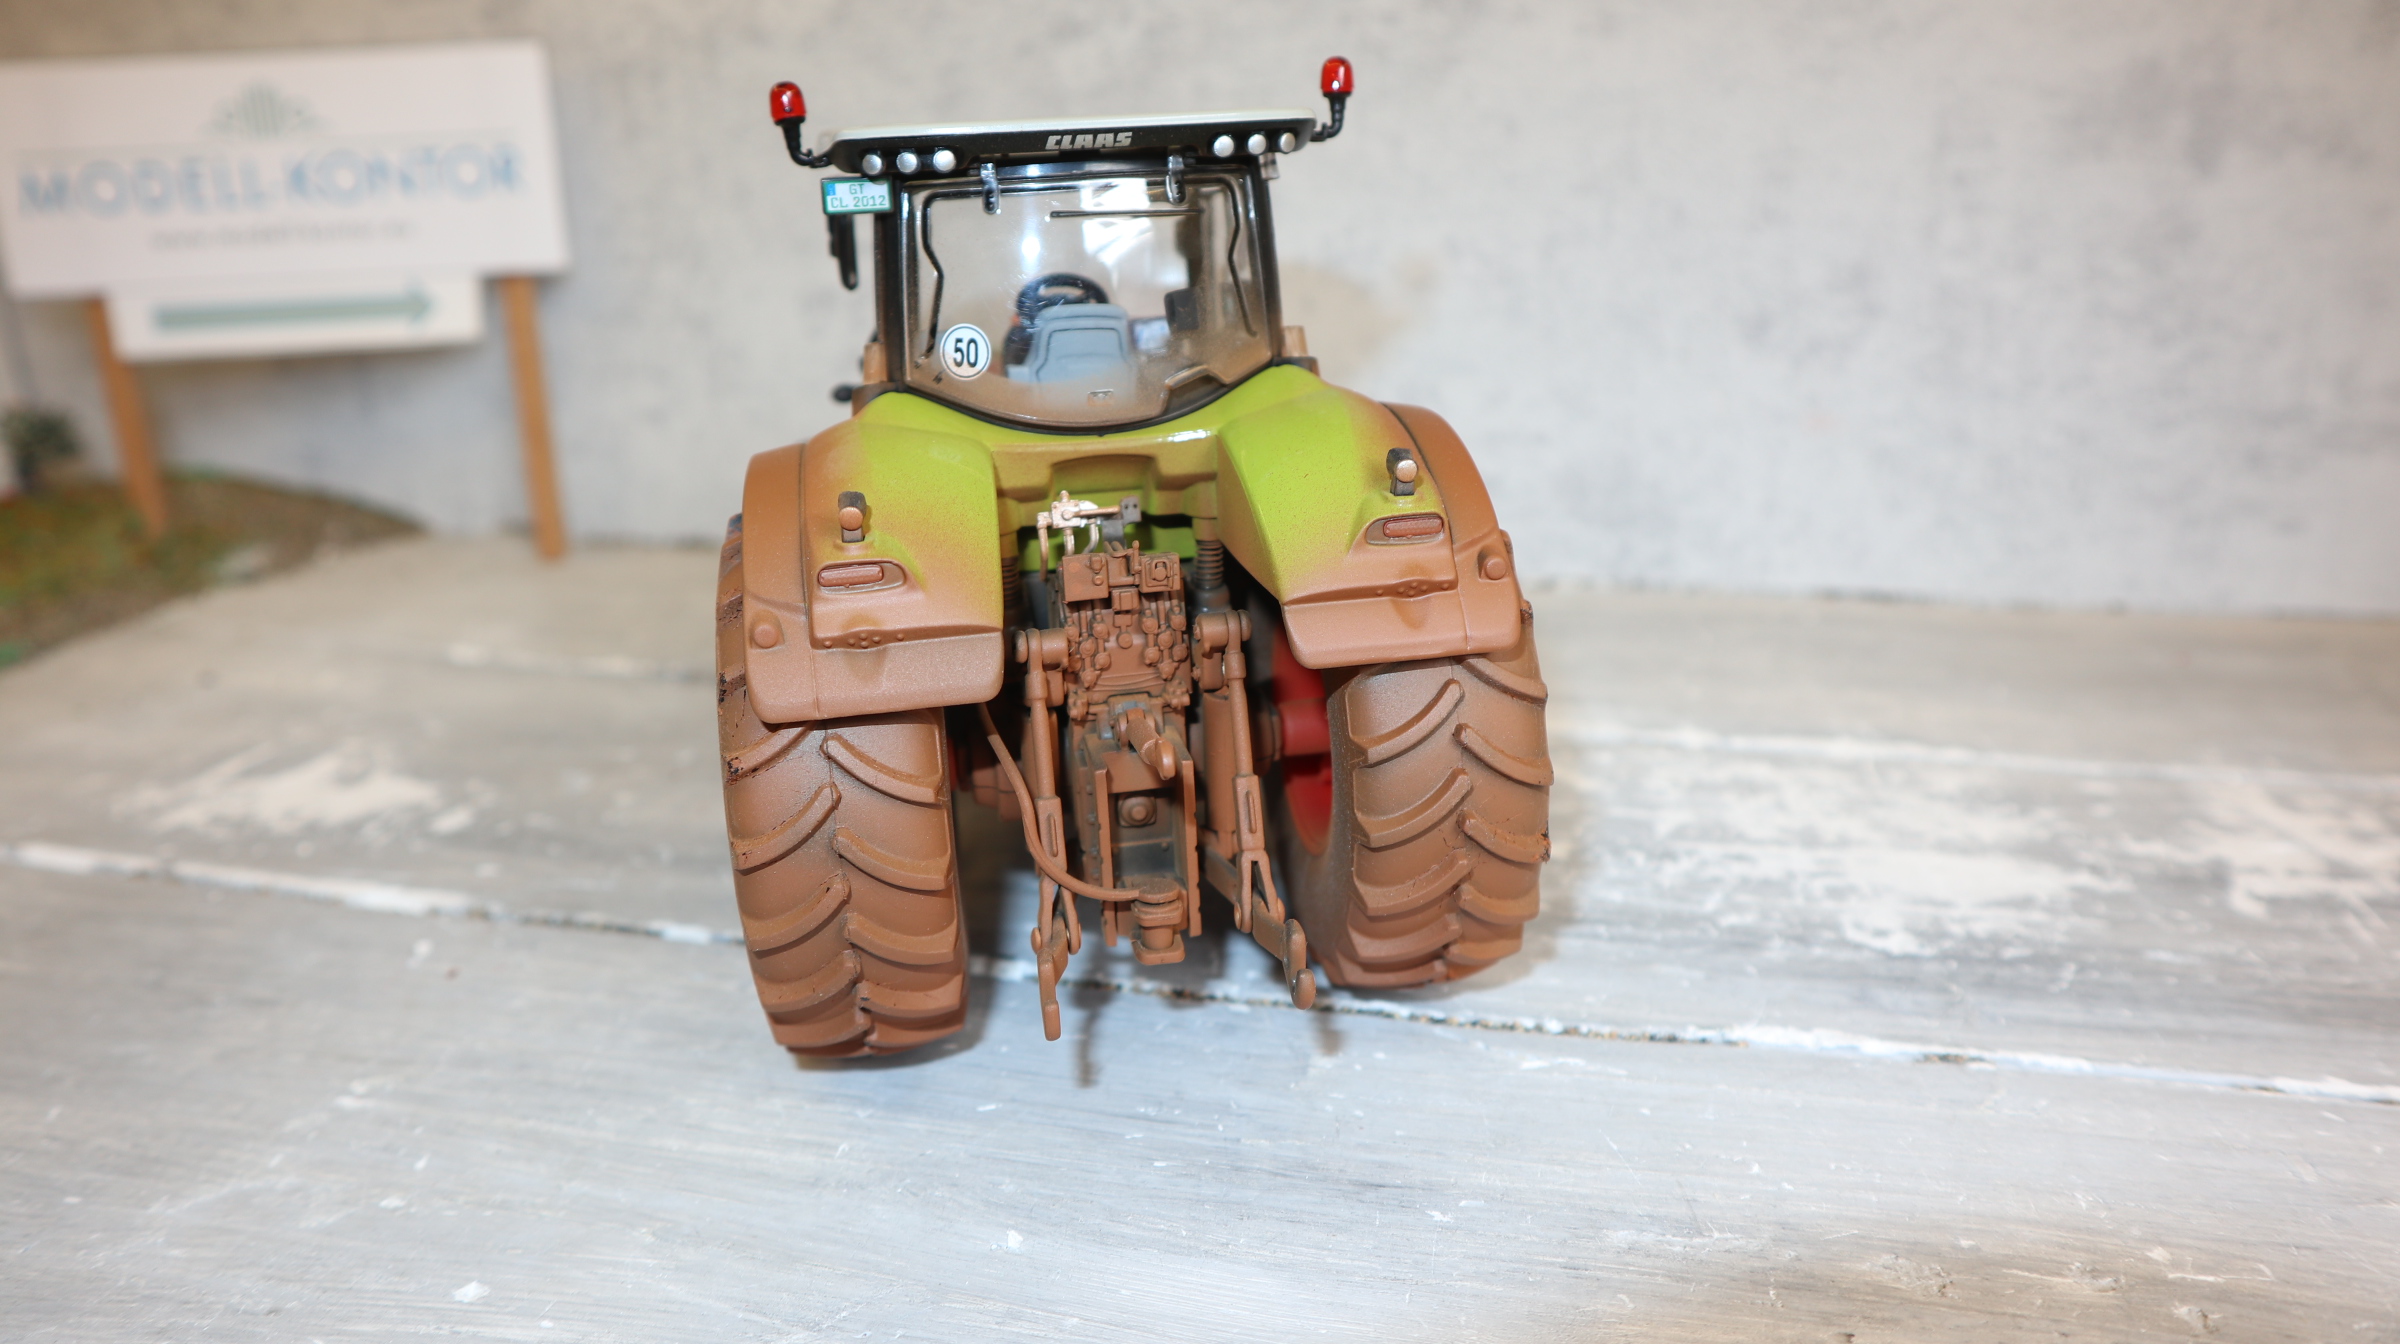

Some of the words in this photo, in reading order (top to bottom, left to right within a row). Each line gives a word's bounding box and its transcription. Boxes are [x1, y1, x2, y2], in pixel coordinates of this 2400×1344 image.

[1045, 131, 1133, 150] CLAAS
[849, 183, 865, 195] GT
[830, 197, 848, 208] CL
[853, 195, 887, 208] 2012
[953, 337, 979, 368] 50
